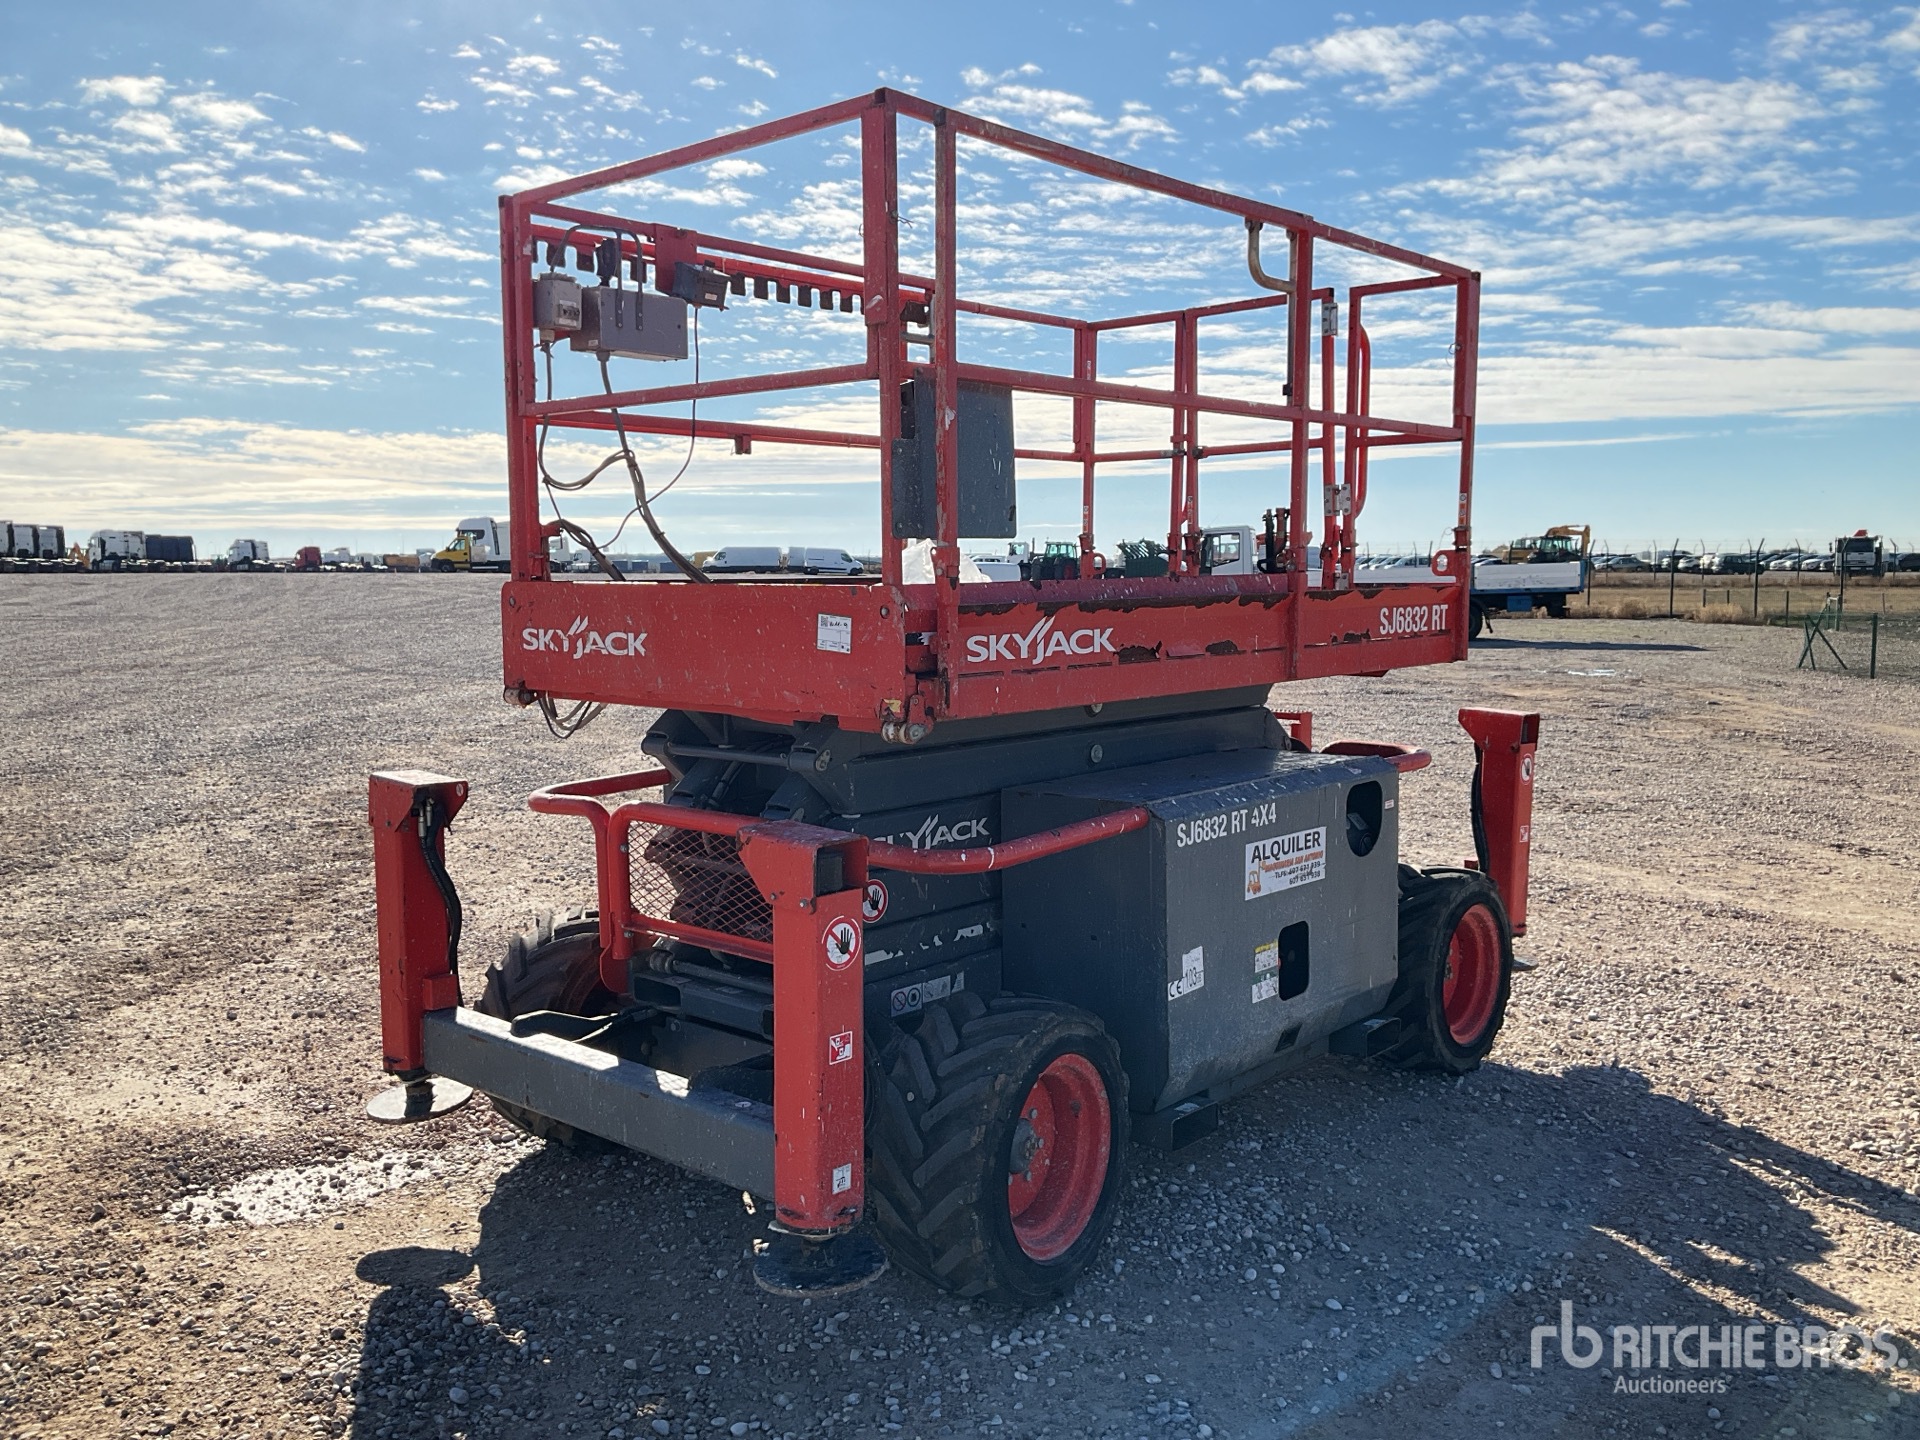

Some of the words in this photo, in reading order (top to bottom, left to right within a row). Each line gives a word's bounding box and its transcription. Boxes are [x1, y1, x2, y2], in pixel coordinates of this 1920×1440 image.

[522, 615, 648, 659] SKYJACK
[1380, 606, 1428, 635] SJ6832
[1432, 605, 1449, 630] RT
[967, 616, 1114, 665] SKYJACK
[872, 814, 990, 850] YJACK
[1177, 814, 1227, 847] SJ6832
[1231, 810, 1248, 834] RT
[1251, 803, 1277, 828] 4X4
[1251, 831, 1321, 863] ALQUILER
